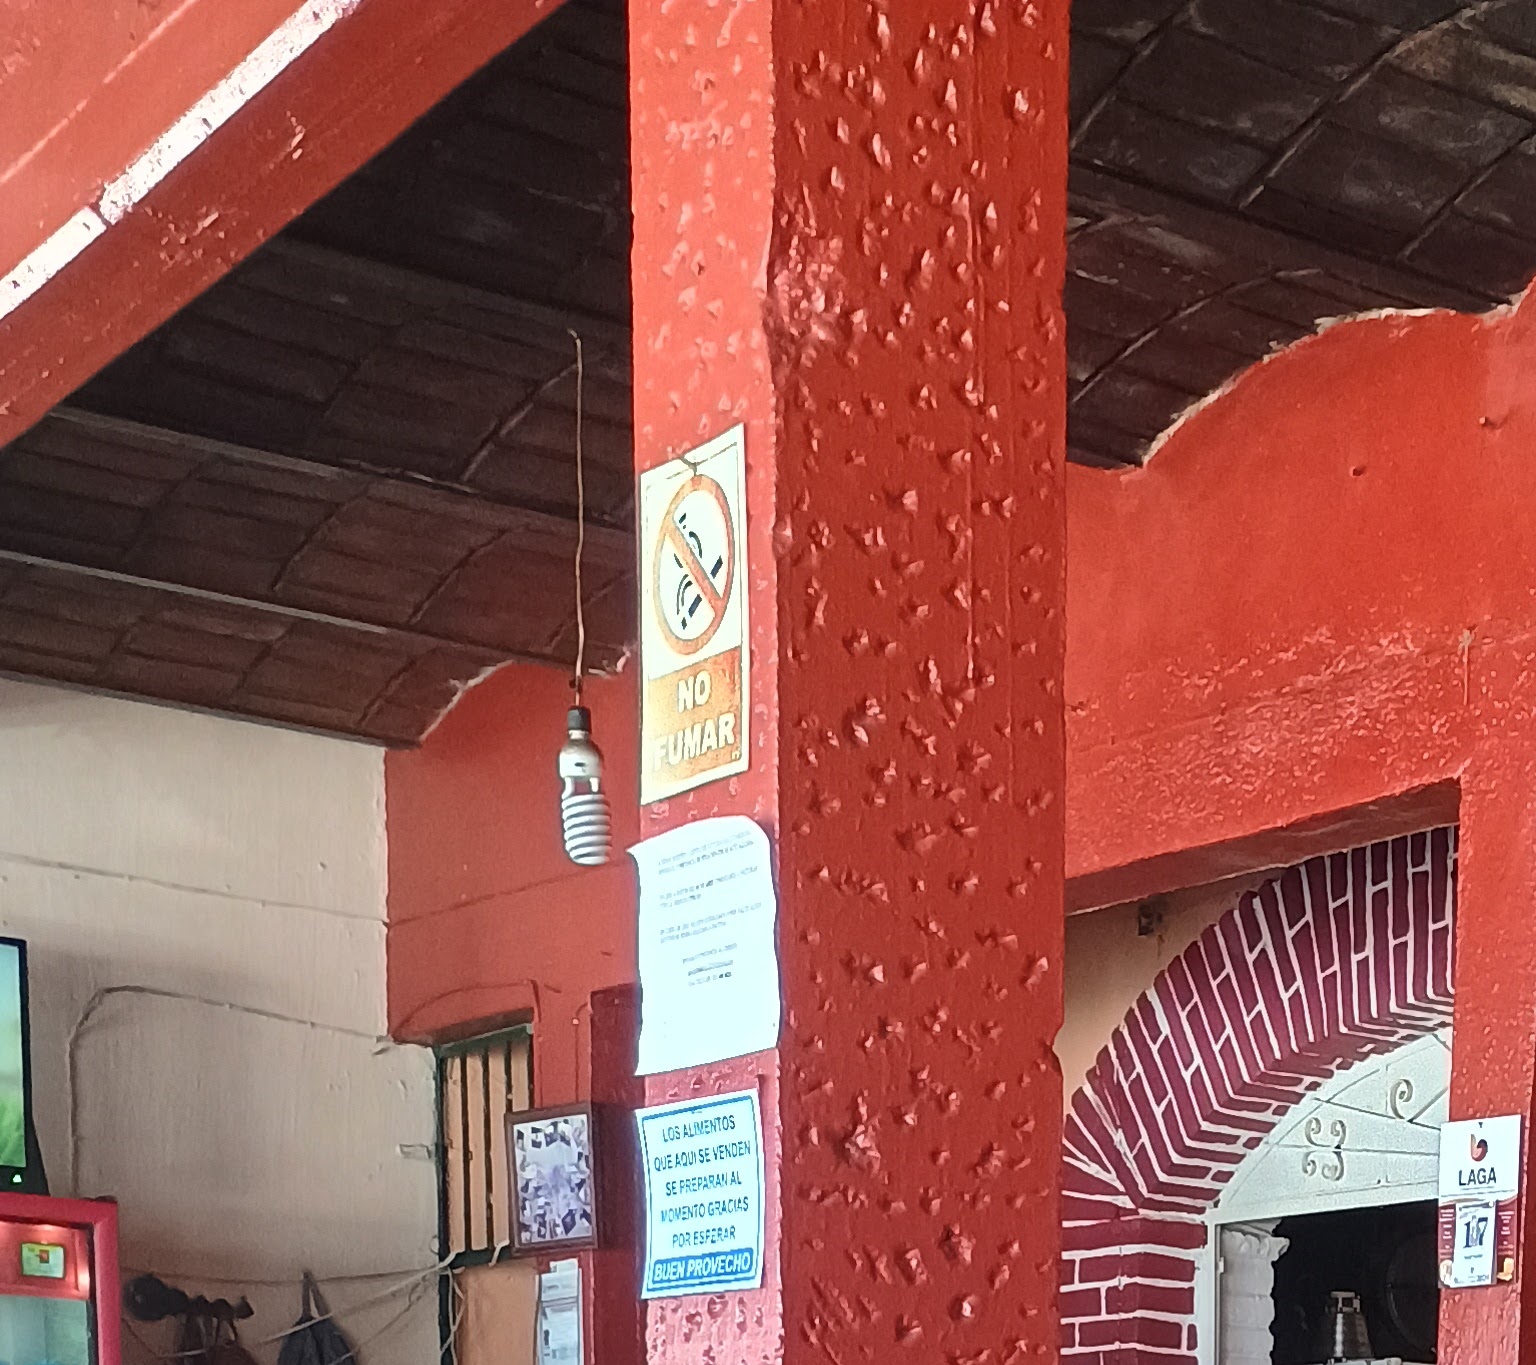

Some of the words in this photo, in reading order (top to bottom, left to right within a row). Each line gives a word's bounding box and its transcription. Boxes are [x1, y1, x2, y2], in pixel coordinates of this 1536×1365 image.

[677, 671, 711, 713] NO
[652, 712, 736, 771] FUMAR
[662, 1126, 680, 1142] LOS
[683, 1115, 735, 1138] ALIMENTOS
[654, 1154, 673, 1171] QUE
[675, 1151, 697, 1168] AQUI
[698, 1147, 711, 1163] SE
[712, 1140, 751, 1161] VENDEN
[665, 1180, 677, 1196] SE
[679, 1173, 728, 1194] PREPARAN
[729, 1171, 742, 1185] AL
[1458, 1167, 1497, 1186] LAGA
[661, 1203, 706, 1223] MOMENTO
[707, 1196, 749, 1216] GRACIAS
[672, 1232, 692, 1248] POR
[694, 1225, 736, 1246] ESPERAR
[654, 1260, 685, 1282] BUEN
[686, 1252, 751, 1278] PROVECHO
